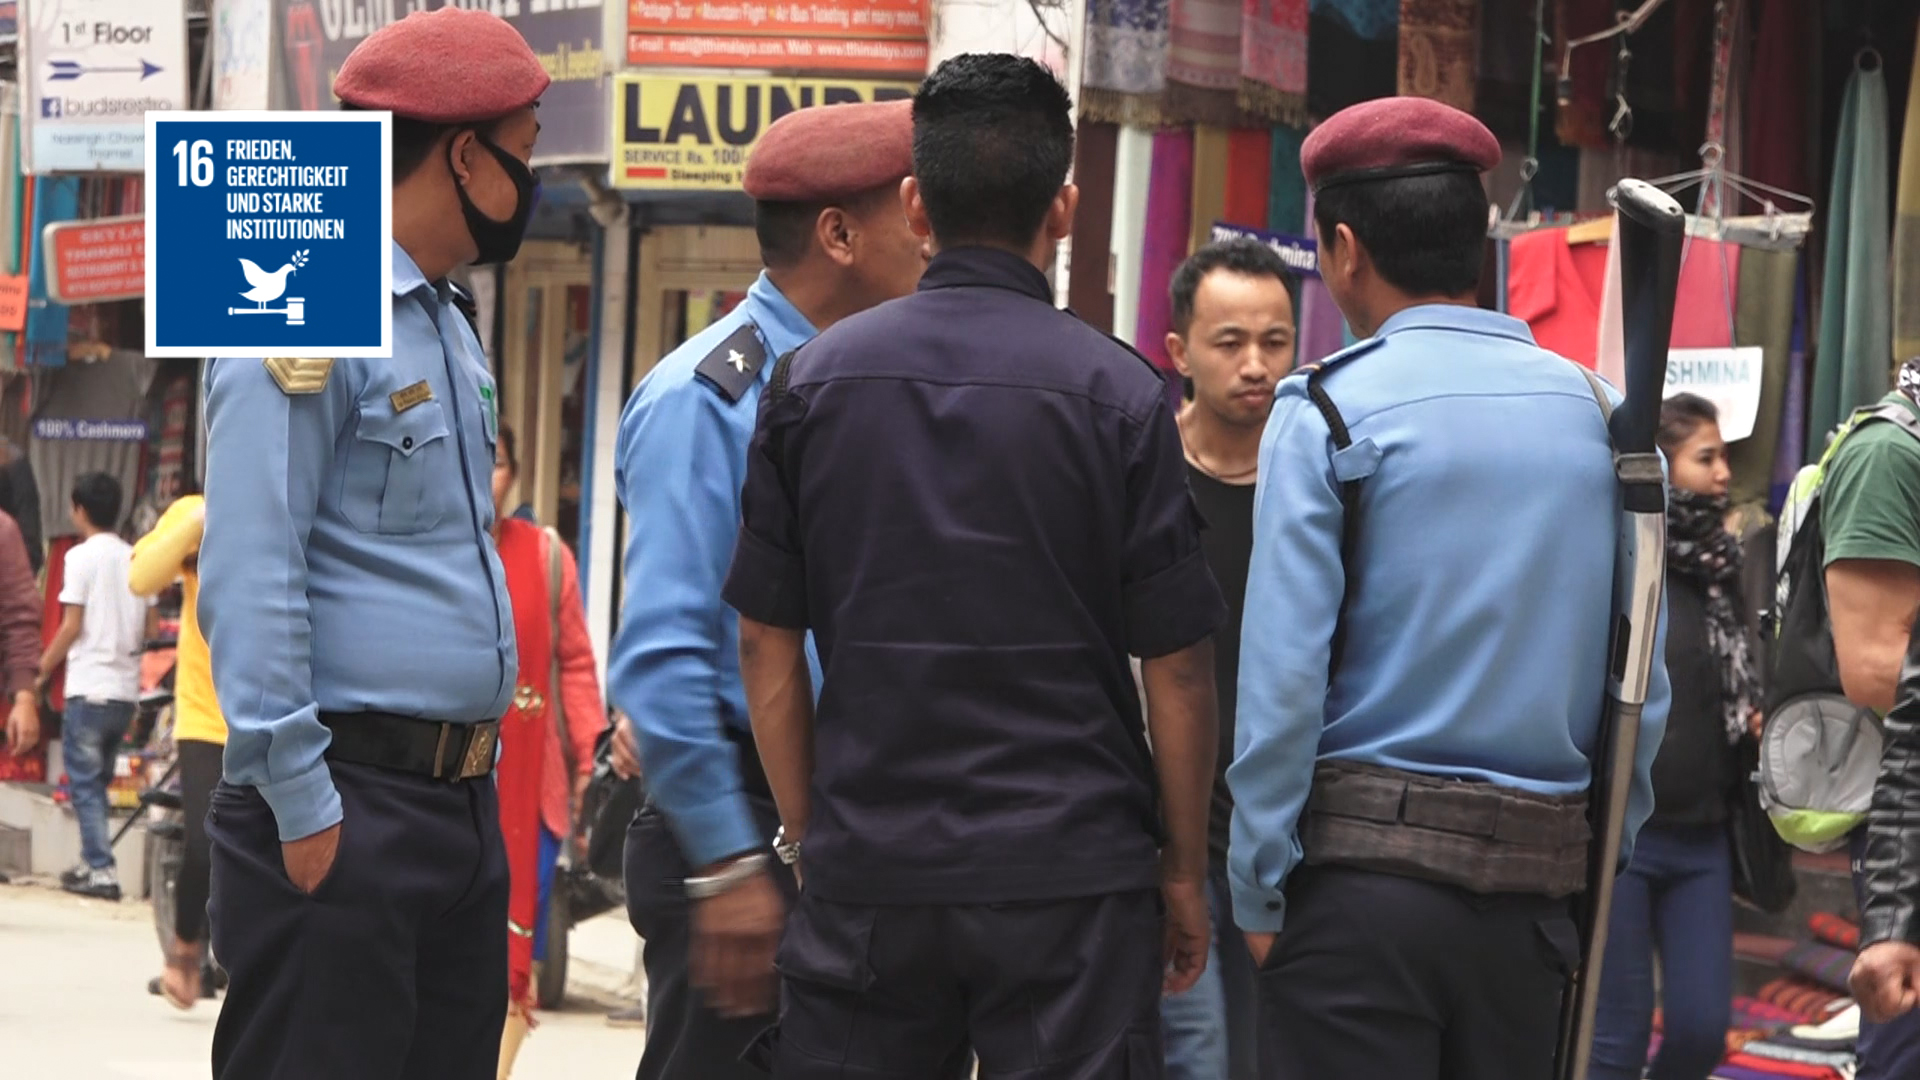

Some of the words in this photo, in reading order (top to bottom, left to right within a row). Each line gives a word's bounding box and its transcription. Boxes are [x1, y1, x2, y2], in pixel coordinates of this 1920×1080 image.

[94, 22, 153, 44] Floor
[624, 150, 681, 164] SERVICE
[671, 168, 732, 184] Sleeping
